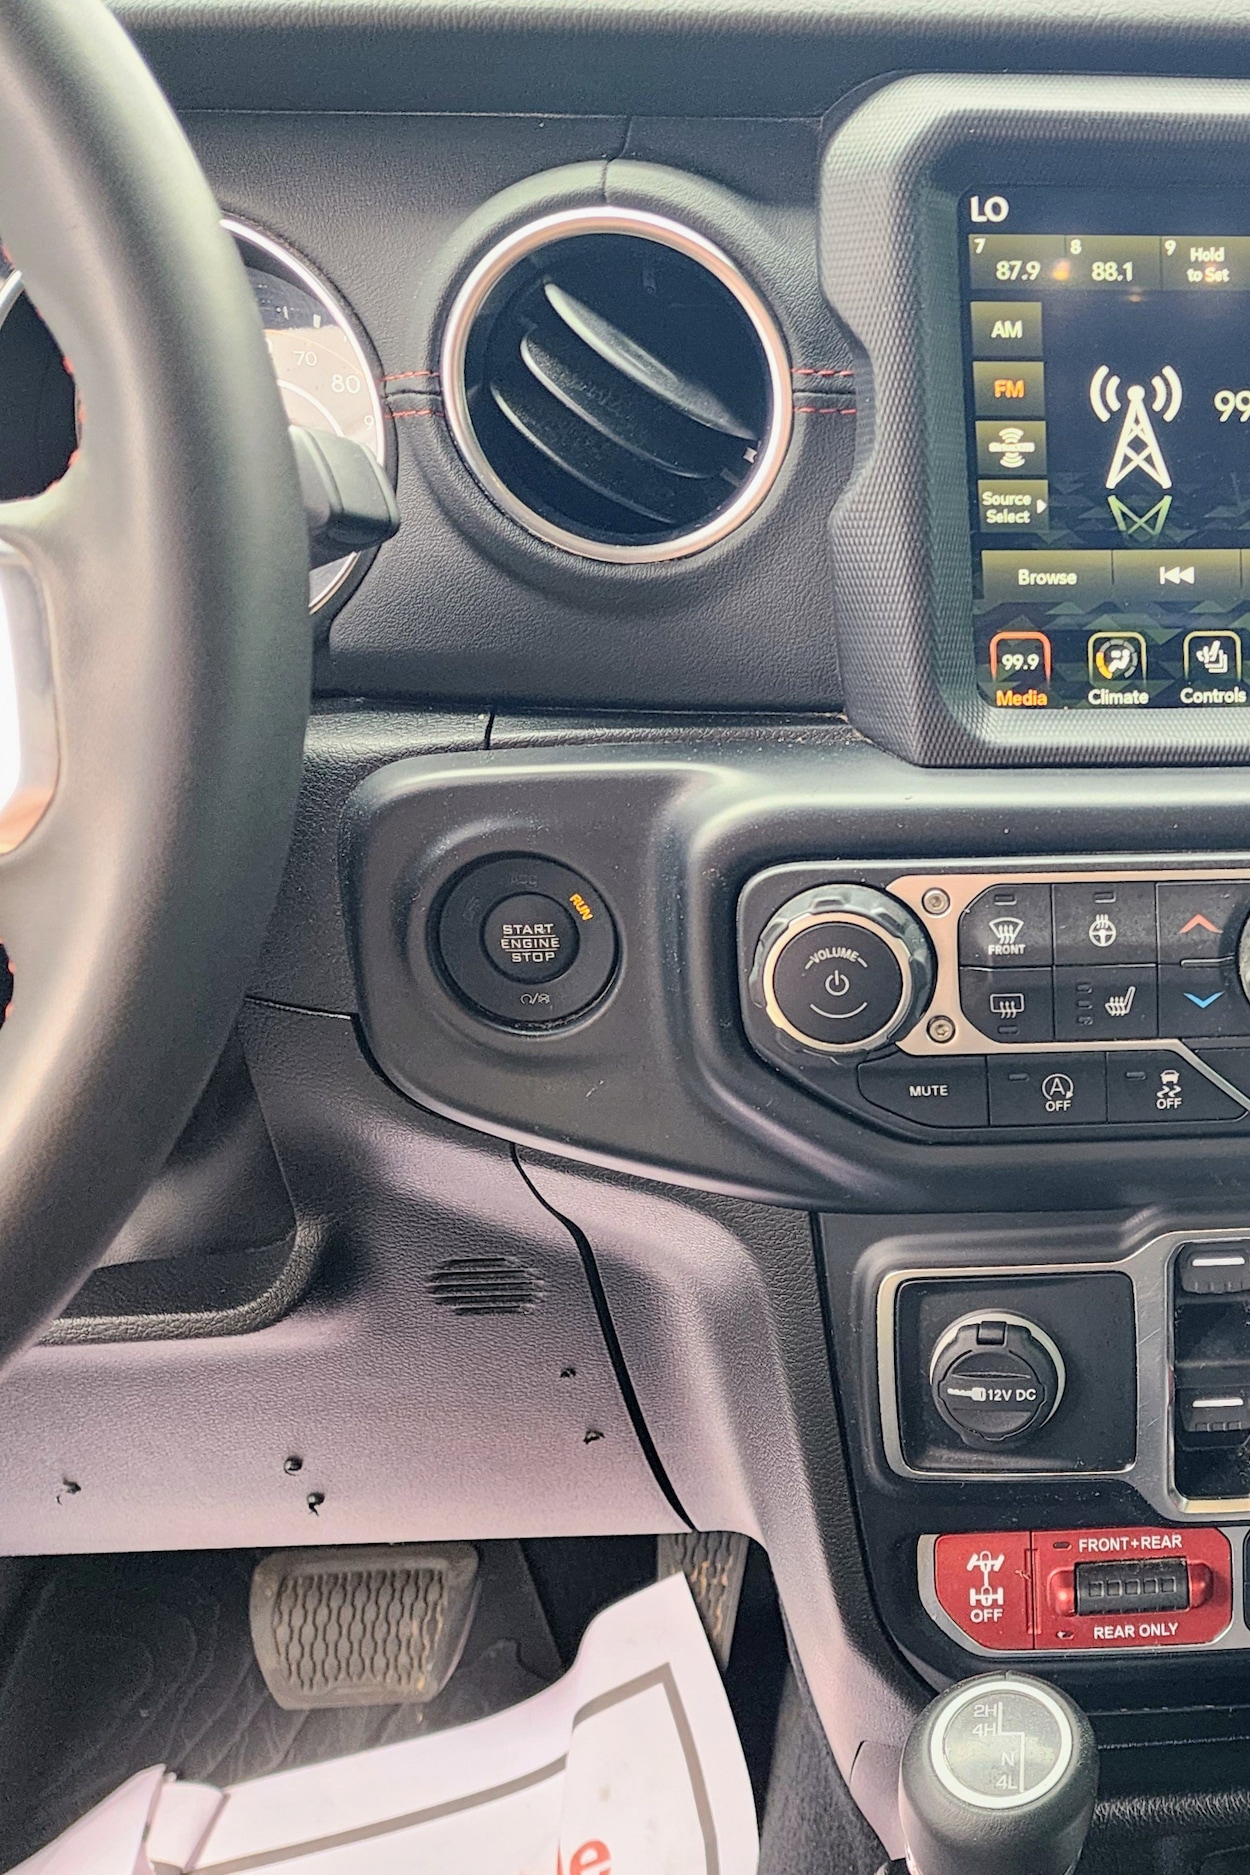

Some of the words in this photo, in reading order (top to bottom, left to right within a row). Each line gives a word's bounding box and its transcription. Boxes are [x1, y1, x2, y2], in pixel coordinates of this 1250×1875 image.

[969, 196, 1010, 223] LO
[973, 238, 986, 254] 7
[1069, 239, 1082, 255] 8
[1164, 240, 1177, 256] 9
[1190, 247, 1225, 262] Hold
[995, 260, 1042, 281] 87.9
[1091, 261, 1134, 282] 88.1
[1186, 267, 1203, 281] to
[1204, 266, 1230, 282] Set
[990, 319, 1023, 338] AM
[293, 351, 318, 367] 70
[330, 374, 362, 395] 80
[993, 379, 1025, 399] FM
[981, 491, 1032, 507] Source
[986, 509, 1031, 525] Select
[1018, 569, 1078, 586] Browse
[1001, 653, 1040, 671] 99.9
[996, 690, 1048, 706] Media
[1087, 689, 1150, 706] Climate
[1180, 687, 1247, 704] Controls
[569, 892, 594, 922] RUN
[502, 923, 555, 935] START
[500, 937, 560, 950] ENGINE
[987, 943, 1026, 956] FRONT
[511, 951, 556, 963] STOP
[808, 946, 860, 964] VOLUME
[909, 1084, 949, 1098] MUTE
[1045, 1100, 1072, 1112] OFF
[1155, 1098, 1183, 1110] OFF
[986, 1387, 1013, 1402] 12V
[1015, 1387, 1038, 1402] DC
[1078, 1533, 1183, 1553] FRONT+REAR
[970, 1608, 1003, 1624] OFF
[1093, 1624, 1136, 1640] REAR
[1138, 1622, 1180, 1638] ONLY
[973, 1704, 998, 1719] 2H
[971, 1722, 996, 1737] 4H
[1001, 1751, 1015, 1767] N
[995, 1774, 1018, 1790] 4L
